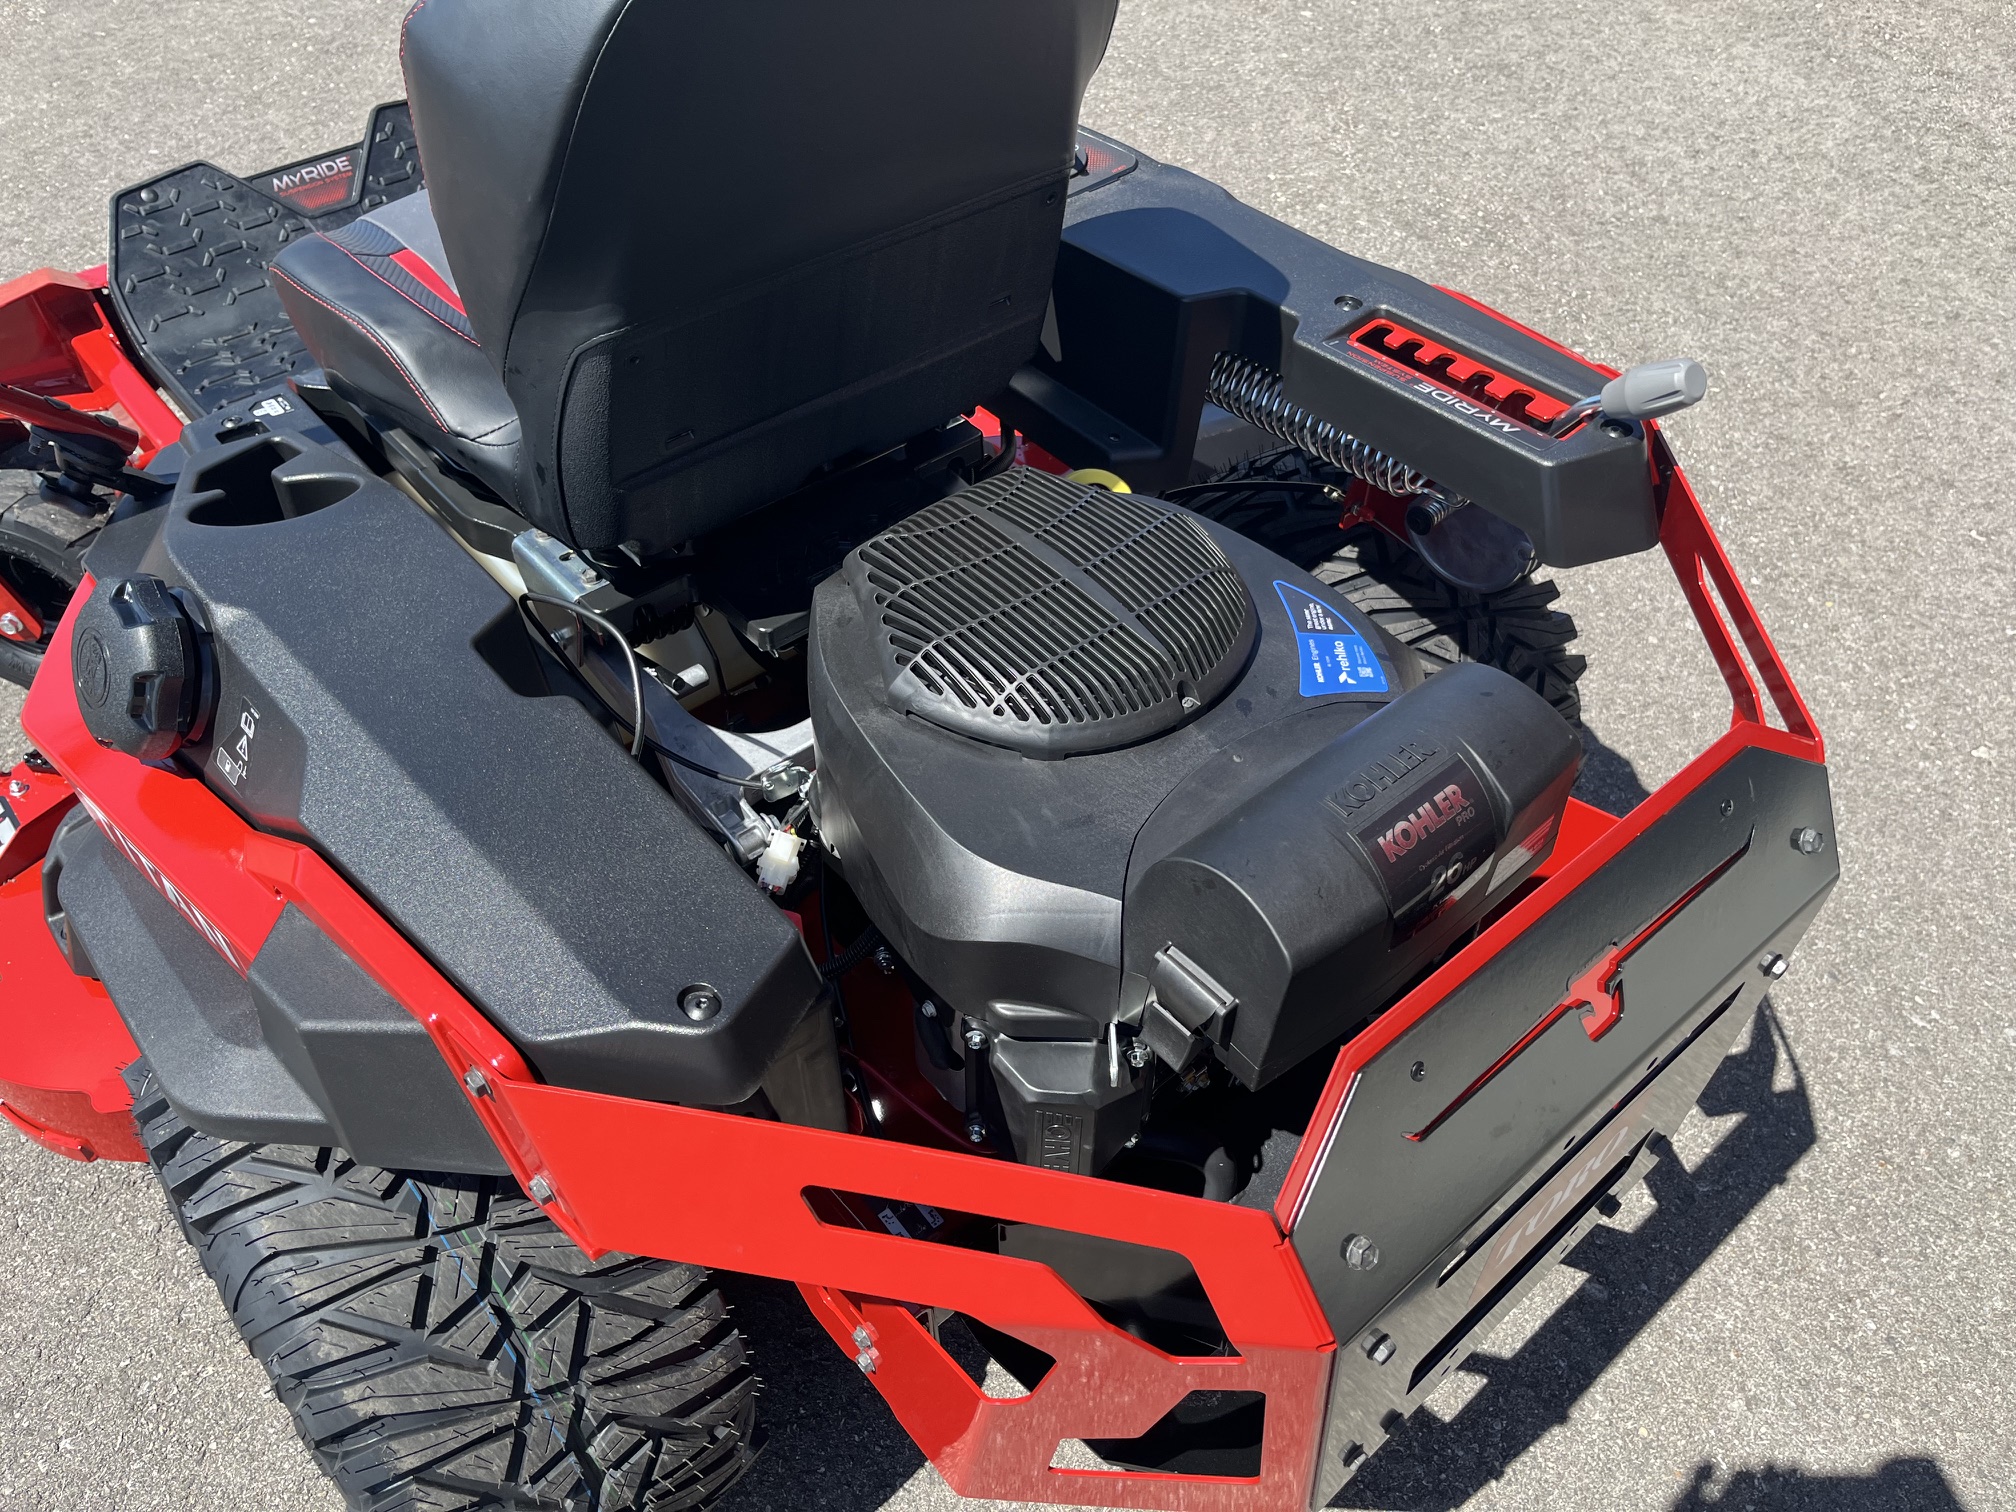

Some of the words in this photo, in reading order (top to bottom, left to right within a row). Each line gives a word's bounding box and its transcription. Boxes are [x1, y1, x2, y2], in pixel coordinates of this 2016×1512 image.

[272, 156, 352, 193] MYRIDE
[1413, 382, 1521, 432] MYRIDE
[1334, 640, 1351, 671] rehlko
[1324, 742, 1440, 818] KOHLER
[1377, 784, 1471, 864] KOHLER
[1455, 806, 1476, 828] PRO
[1429, 851, 1464, 902] 26
[1496, 1125, 1630, 1270] TORO
